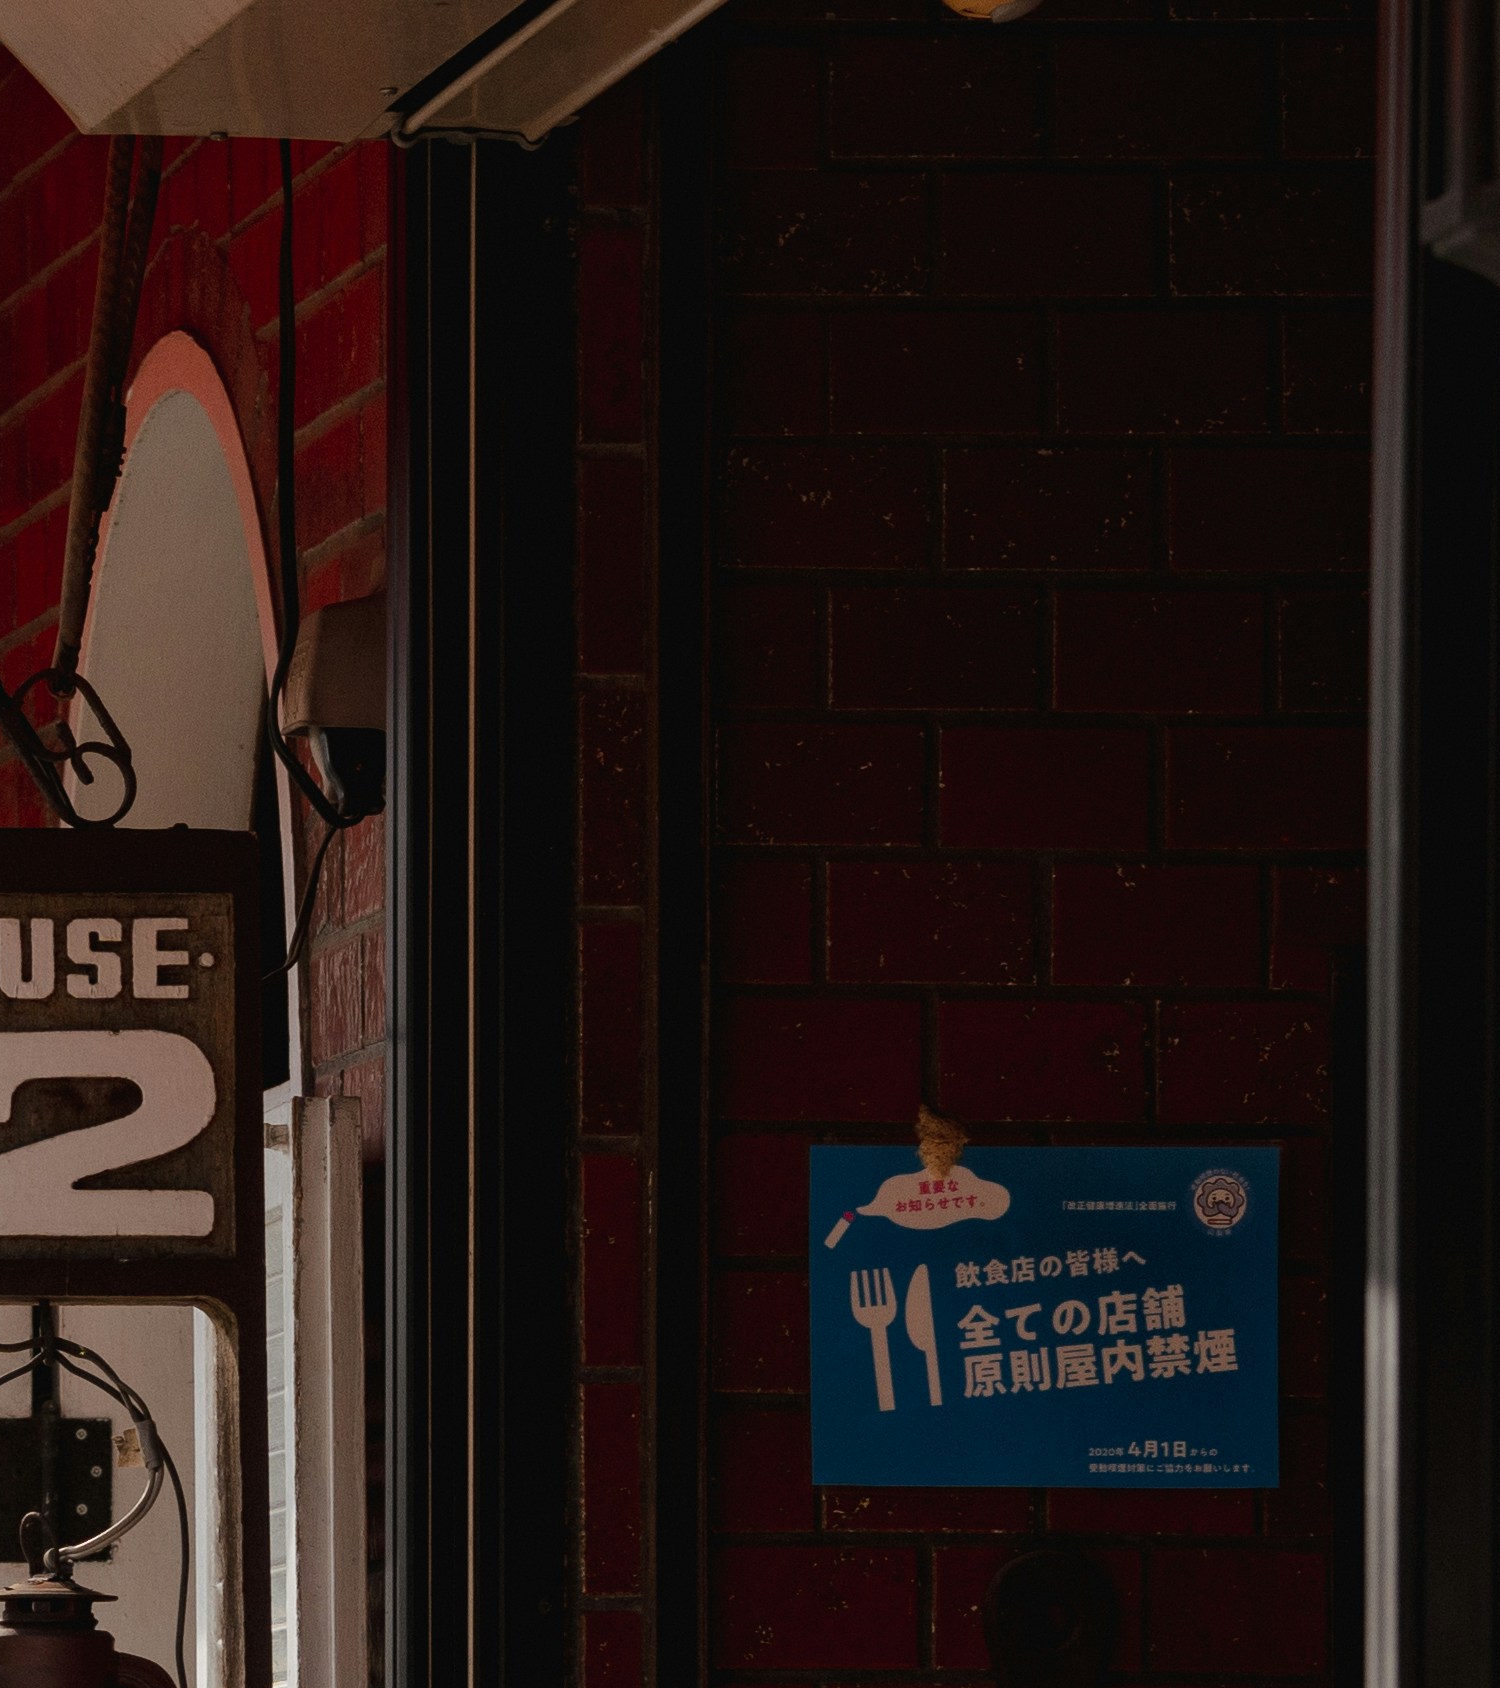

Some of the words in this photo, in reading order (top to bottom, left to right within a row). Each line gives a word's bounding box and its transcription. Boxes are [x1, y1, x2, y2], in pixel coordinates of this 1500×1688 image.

[918, 1179, 960, 1195] 重要な
[954, 1247, 1147, 1289] 飲食店の皆様へ
[957, 1283, 1187, 1350] 全ての店舗
[963, 1328, 1239, 1398] 原則屋内禁煙
